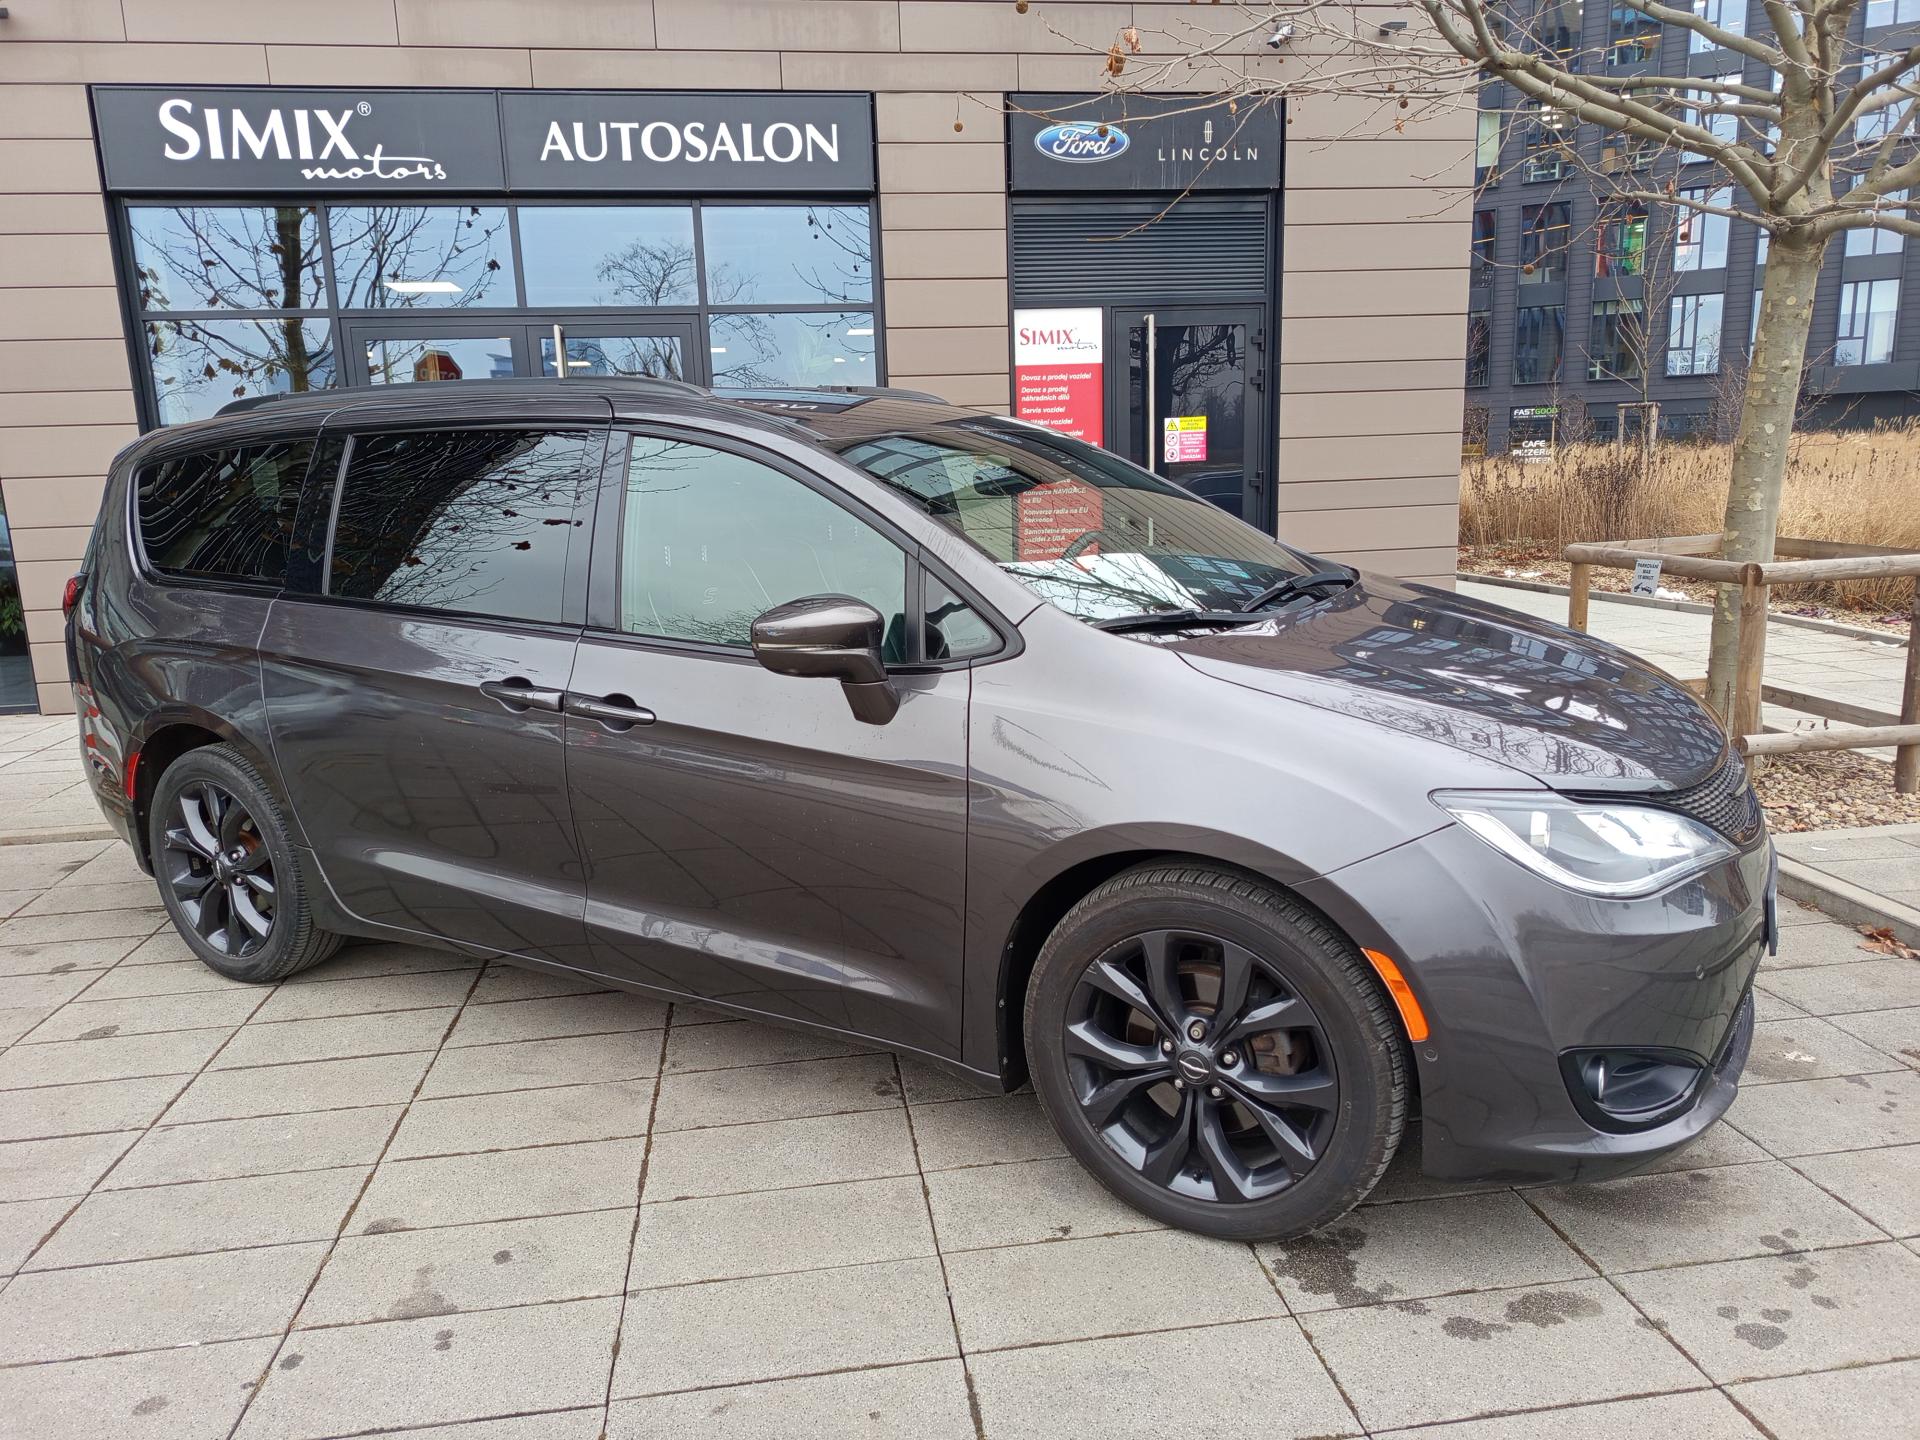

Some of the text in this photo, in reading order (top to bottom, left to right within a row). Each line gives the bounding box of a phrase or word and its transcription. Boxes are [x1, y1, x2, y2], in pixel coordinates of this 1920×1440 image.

[539, 120, 839, 163] AUTOSALON
[1052, 126, 1111, 156] Ford
[301, 143, 448, 181] motors
[1157, 147, 1259, 162] LINCOLN
[1019, 327, 1074, 346] SIMIX
[1047, 374, 1069, 382] prodej
[1069, 372, 1092, 380] vozidel
[1047, 386, 1069, 394] prodej
[1513, 407, 1558, 415] FASTGOOD
[1522, 440, 1546, 448] CAFE
